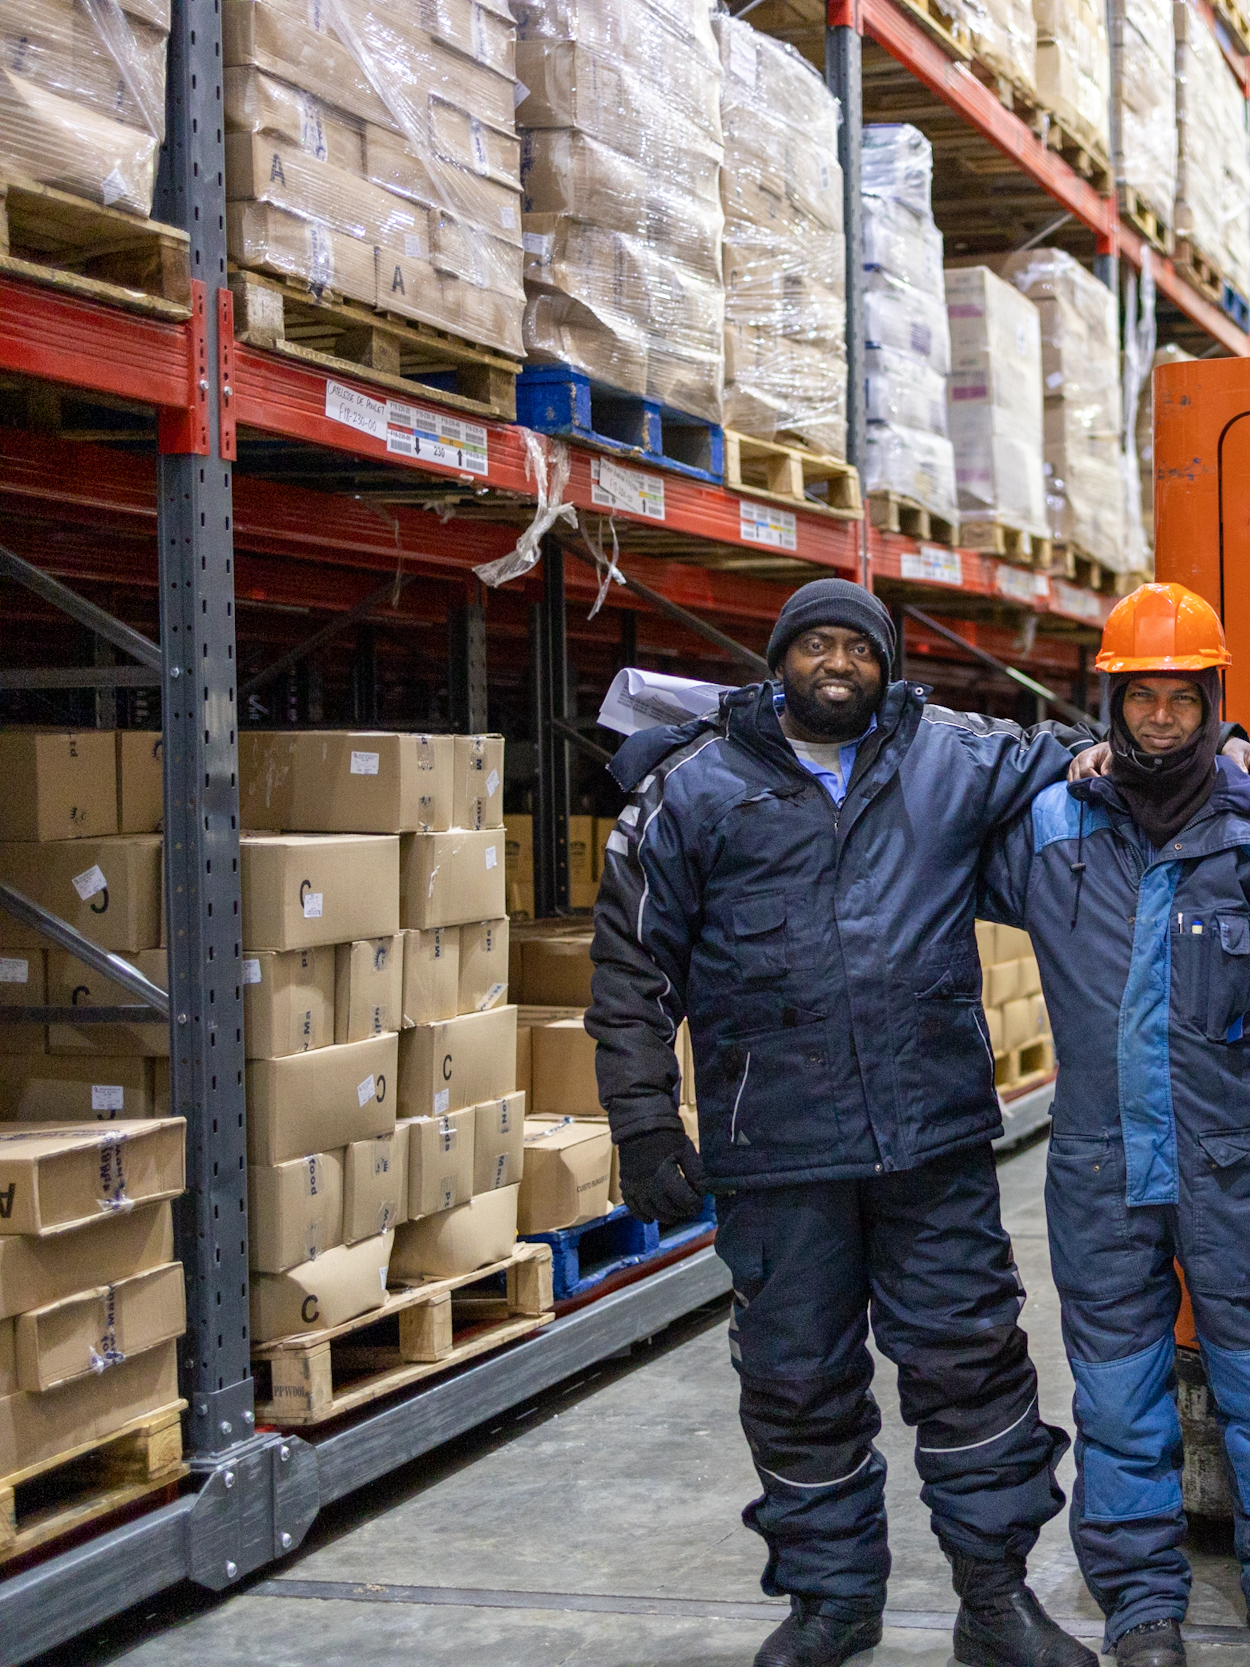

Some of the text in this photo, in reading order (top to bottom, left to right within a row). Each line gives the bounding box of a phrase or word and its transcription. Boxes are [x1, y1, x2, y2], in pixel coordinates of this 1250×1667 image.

[270, 153, 287, 188] A
[392, 265, 406, 296] A
[433, 445, 446, 458] 230
[443, 1053, 453, 1081] C
[376, 1074, 386, 1103] C
[301, 1294, 320, 1323] C
